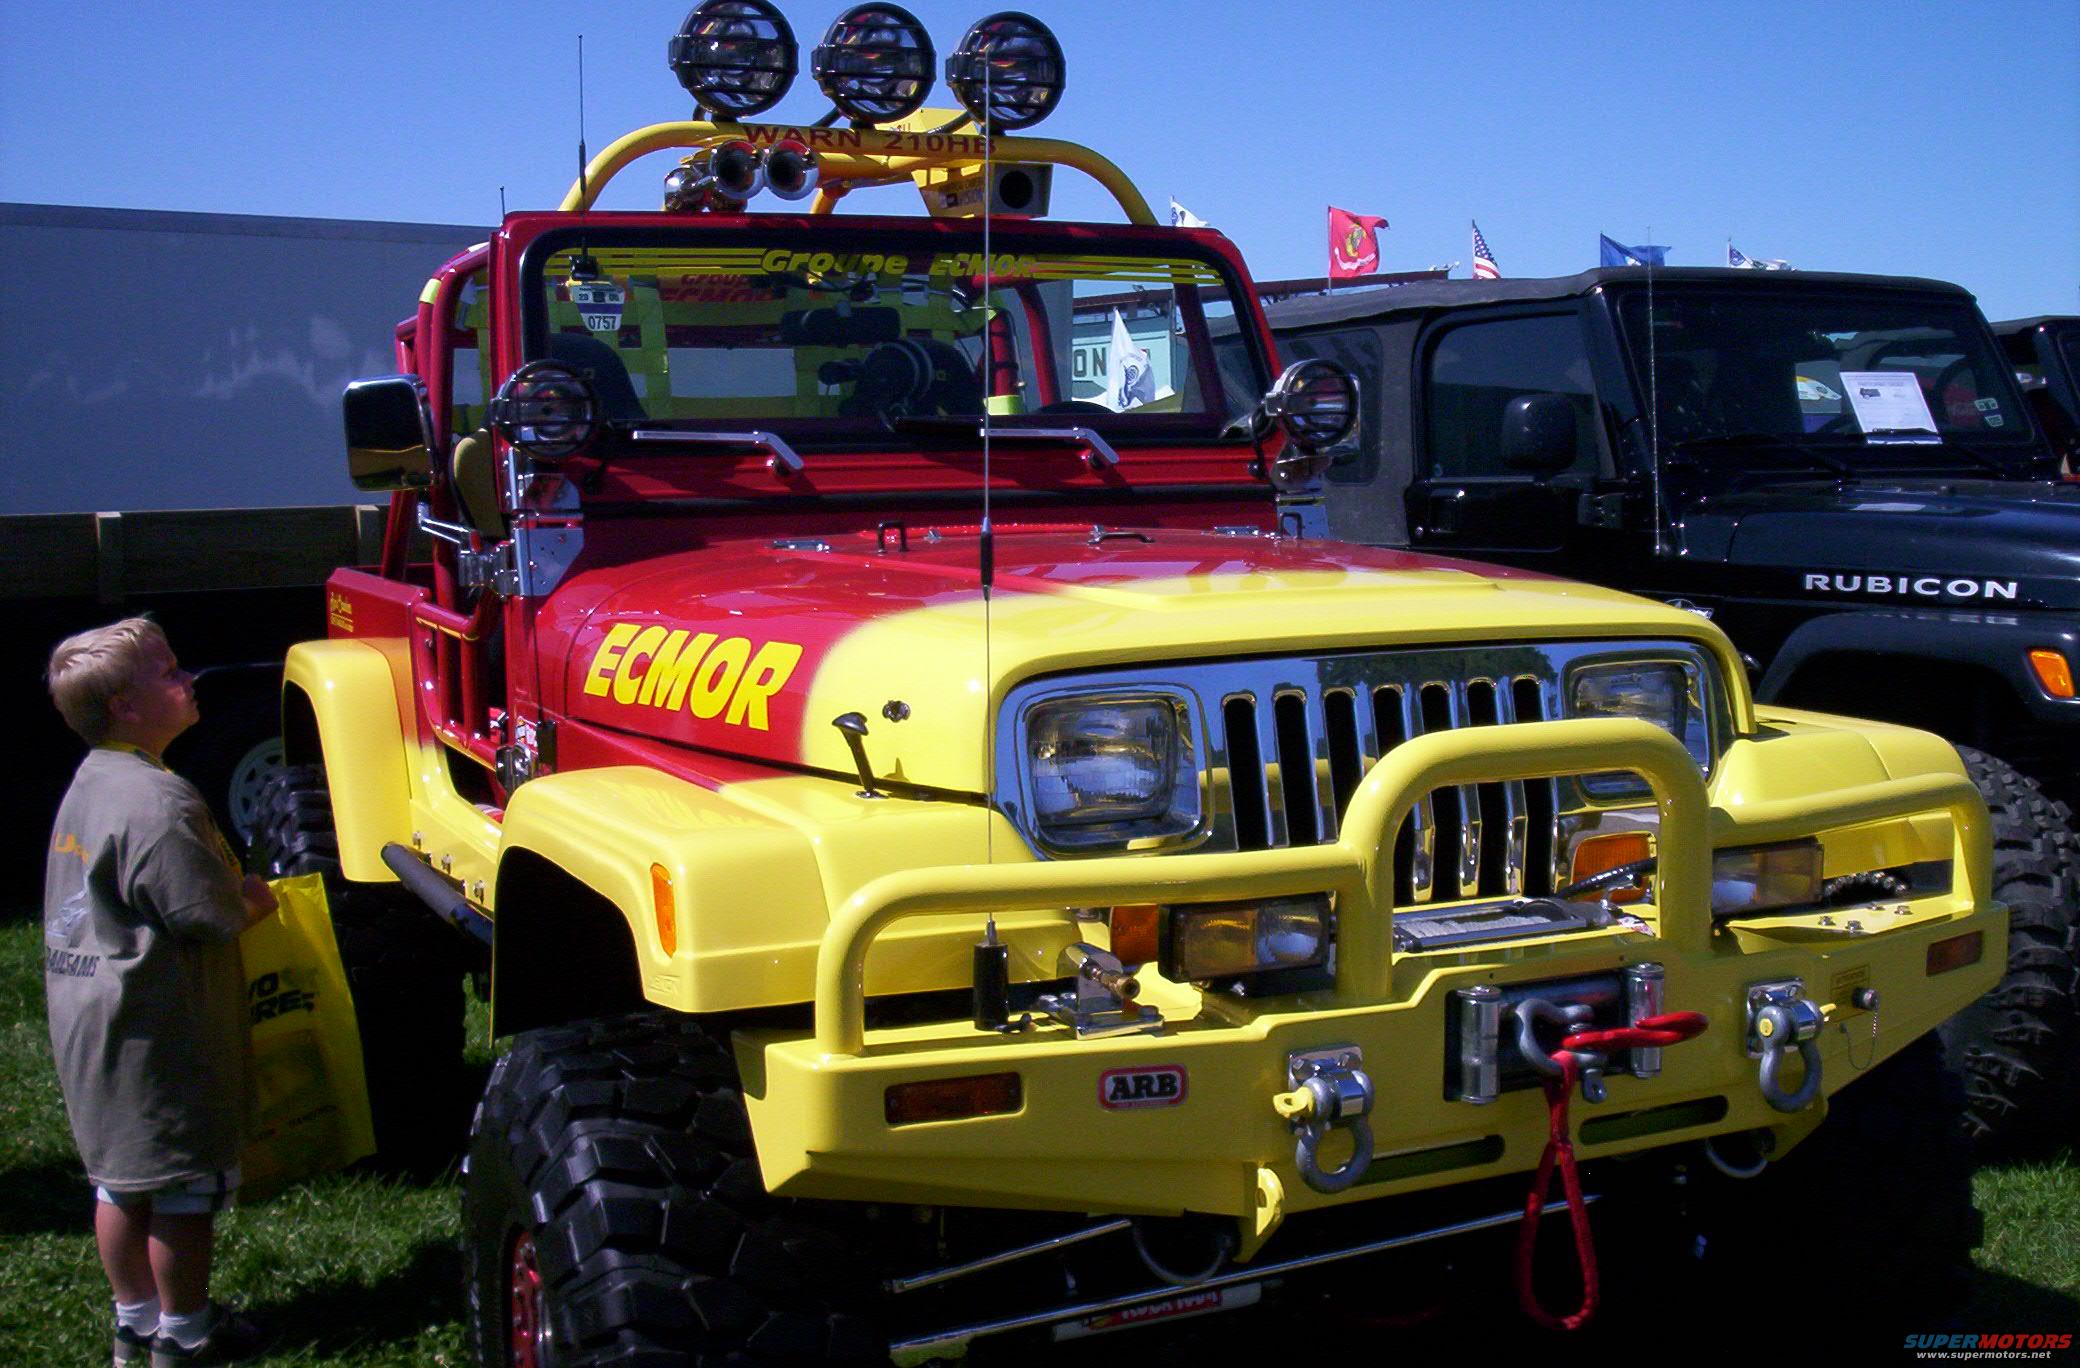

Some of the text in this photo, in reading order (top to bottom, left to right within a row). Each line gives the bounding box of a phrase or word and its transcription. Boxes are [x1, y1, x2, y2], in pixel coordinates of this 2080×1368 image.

[744, 126, 997, 154] WARN 210HB
[928, 252, 1036, 278] ECMOR
[588, 315, 617, 330] 0757
[1804, 573, 2018, 599] RUBICON
[583, 622, 804, 732] ECMOR
[1109, 1072, 1179, 1101] ARB
